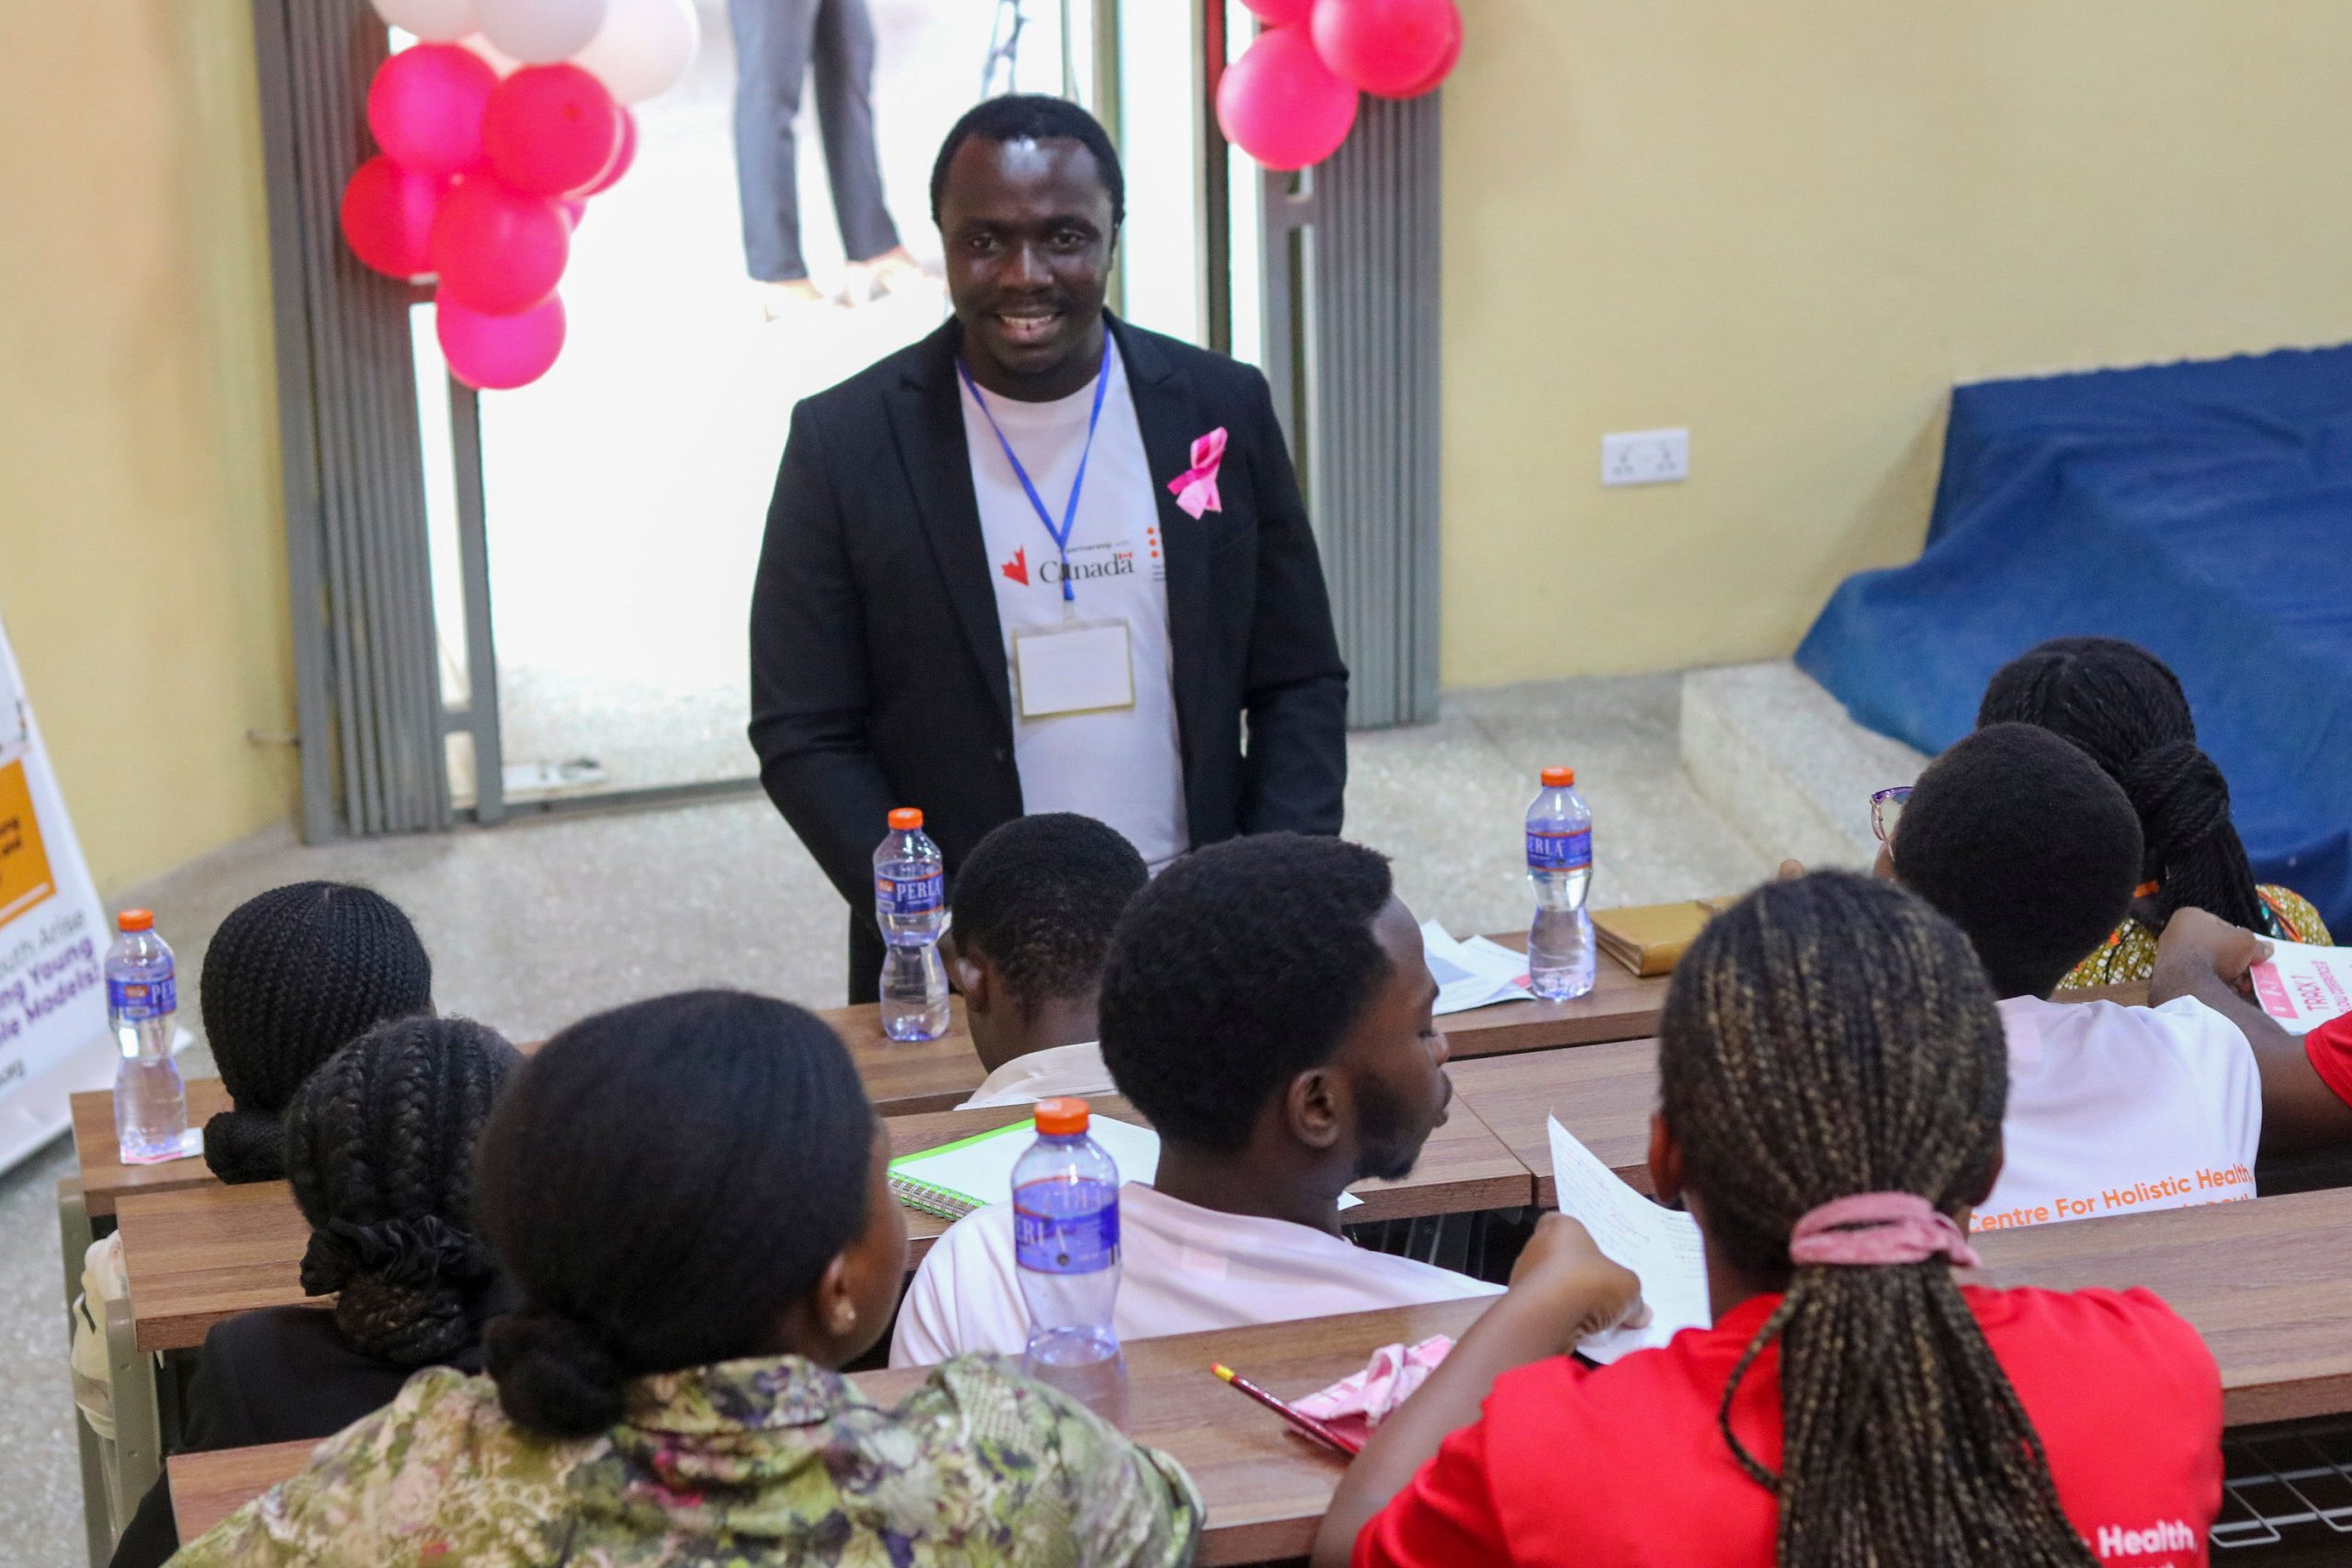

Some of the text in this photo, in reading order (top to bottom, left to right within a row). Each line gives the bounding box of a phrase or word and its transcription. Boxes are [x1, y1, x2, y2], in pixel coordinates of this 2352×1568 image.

[1039, 553, 1136, 584] Cnada
[28, 936, 95, 987] Young
[2055, 1198, 2096, 1219] For
[2102, 1177, 2191, 1210] Holistic
